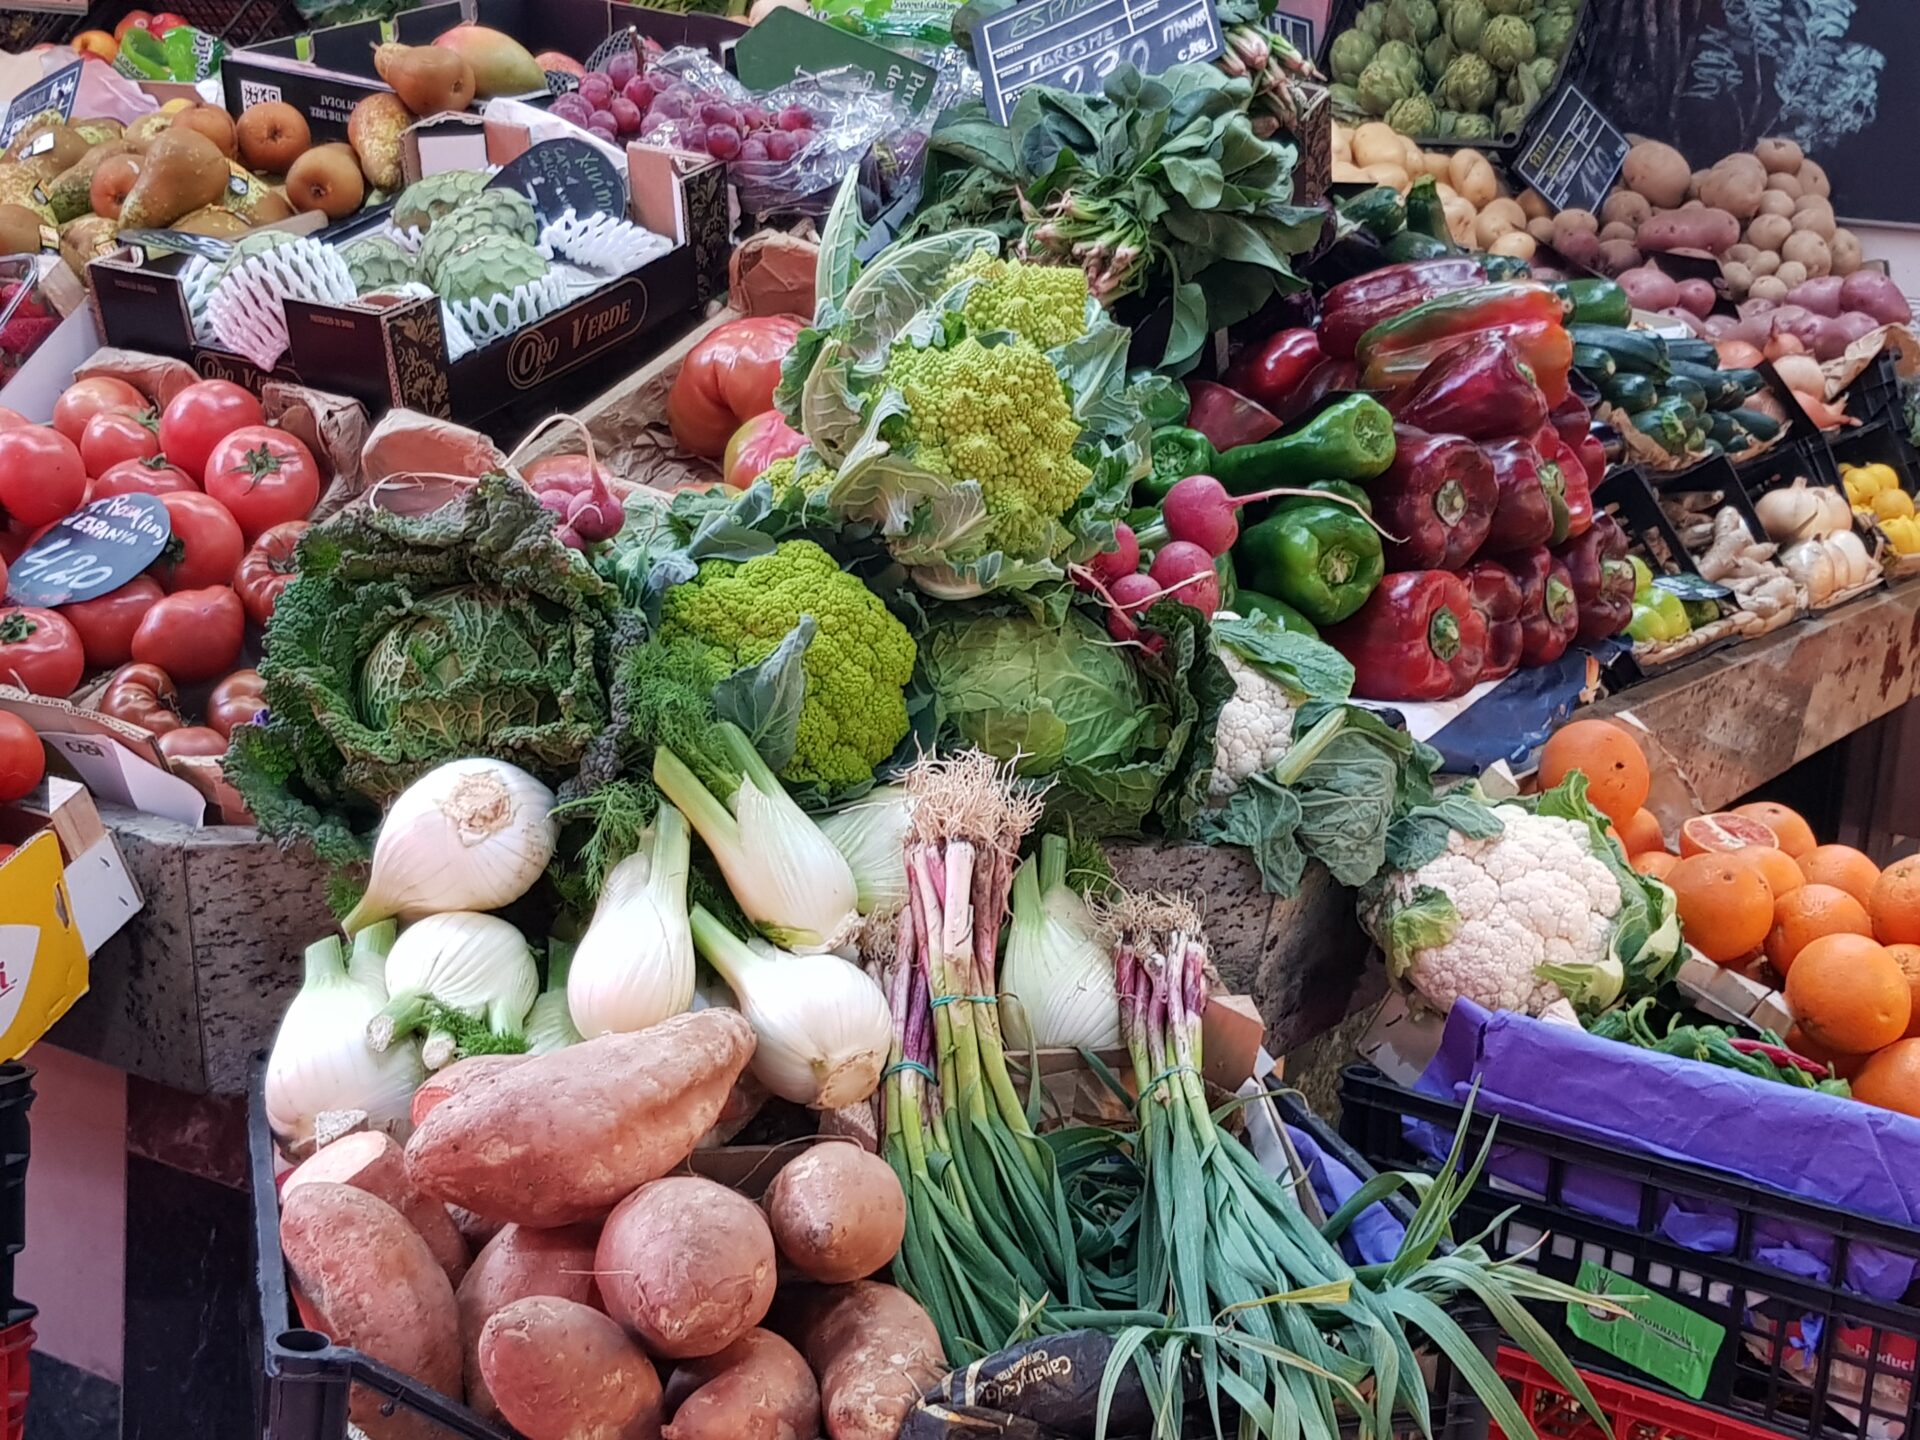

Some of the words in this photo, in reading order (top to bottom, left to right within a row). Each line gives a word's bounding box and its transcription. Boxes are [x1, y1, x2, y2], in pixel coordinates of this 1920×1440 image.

[1029, 28, 1115, 75] MARESME
[884, 64, 904, 89] de
[518, 335, 560, 376] ORO
[571, 299, 632, 349] VERDE
